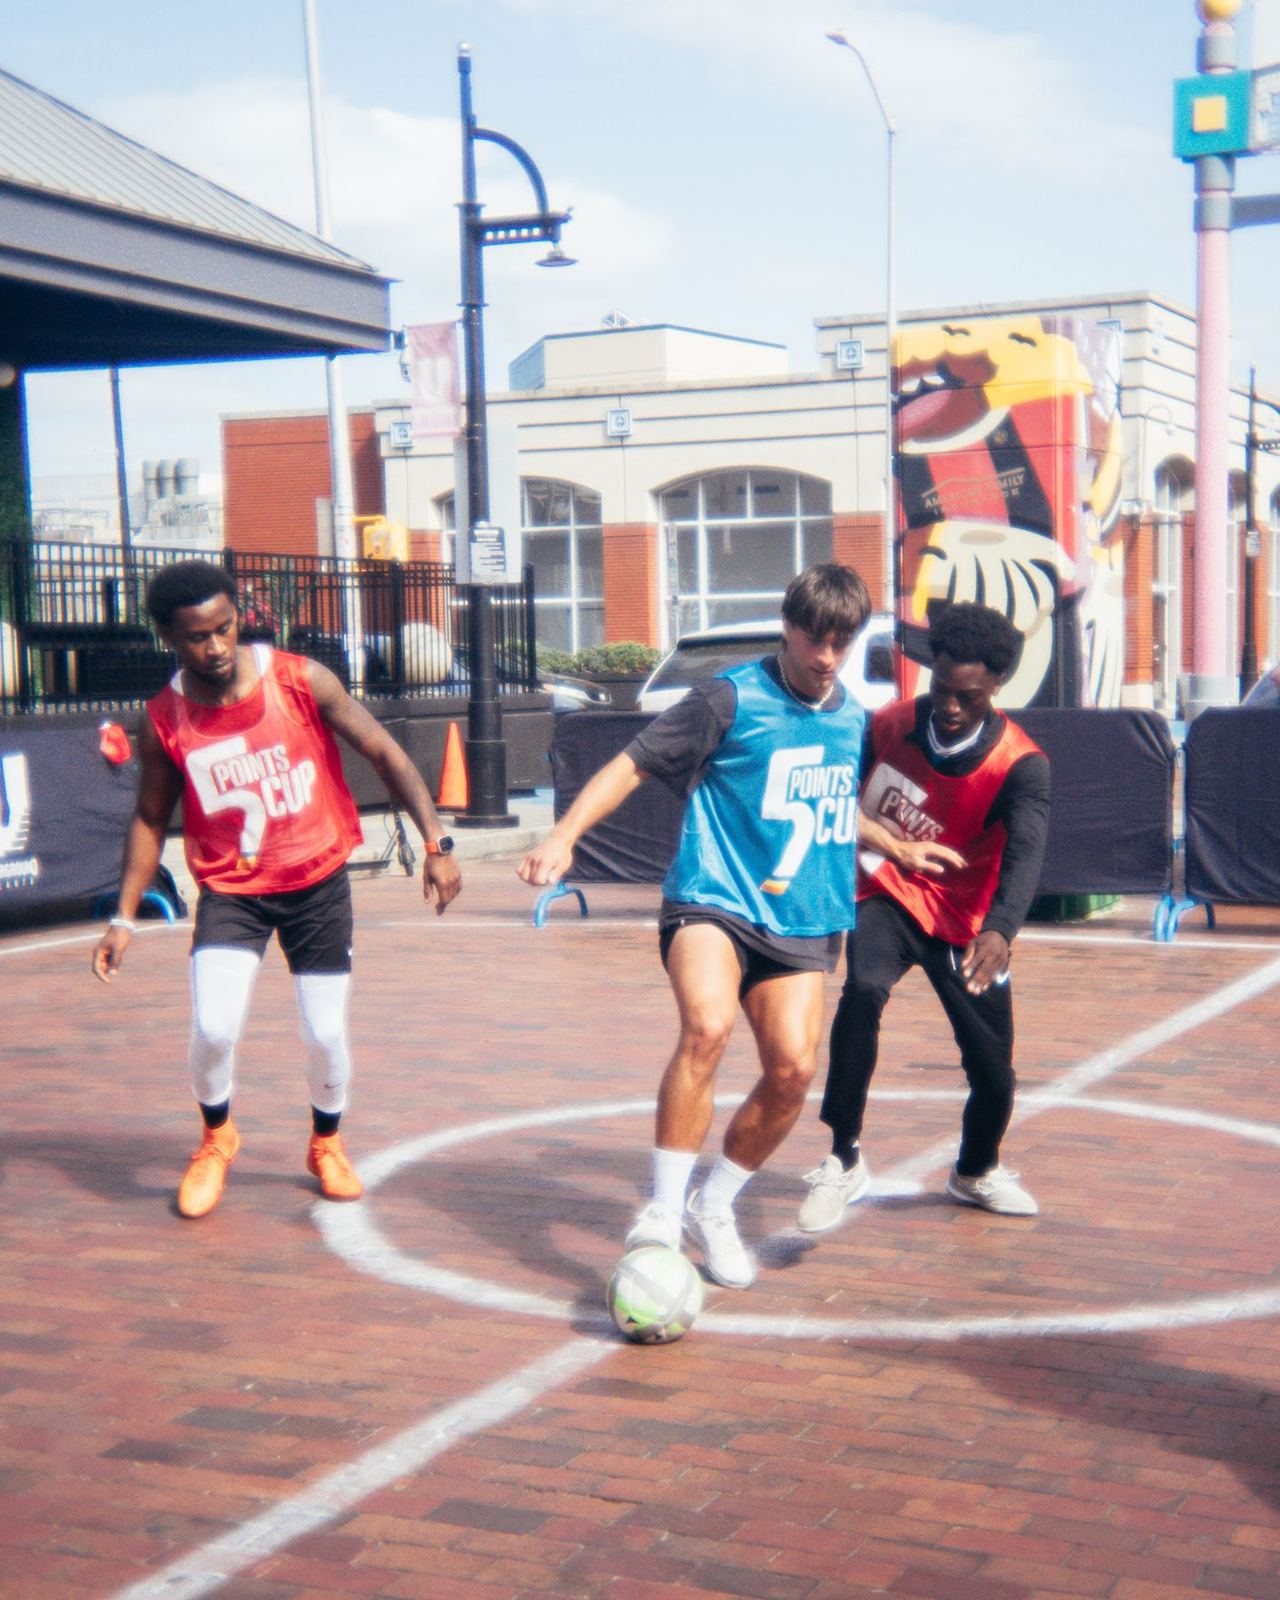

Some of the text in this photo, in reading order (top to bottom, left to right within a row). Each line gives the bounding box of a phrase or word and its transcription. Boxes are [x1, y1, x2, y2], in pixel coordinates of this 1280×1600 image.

[185, 735, 290, 870] 5 POINTS
[260, 759, 316, 818] CUP
[761, 745, 855, 894] 5 POINTS
[815, 796, 857, 845] CU
